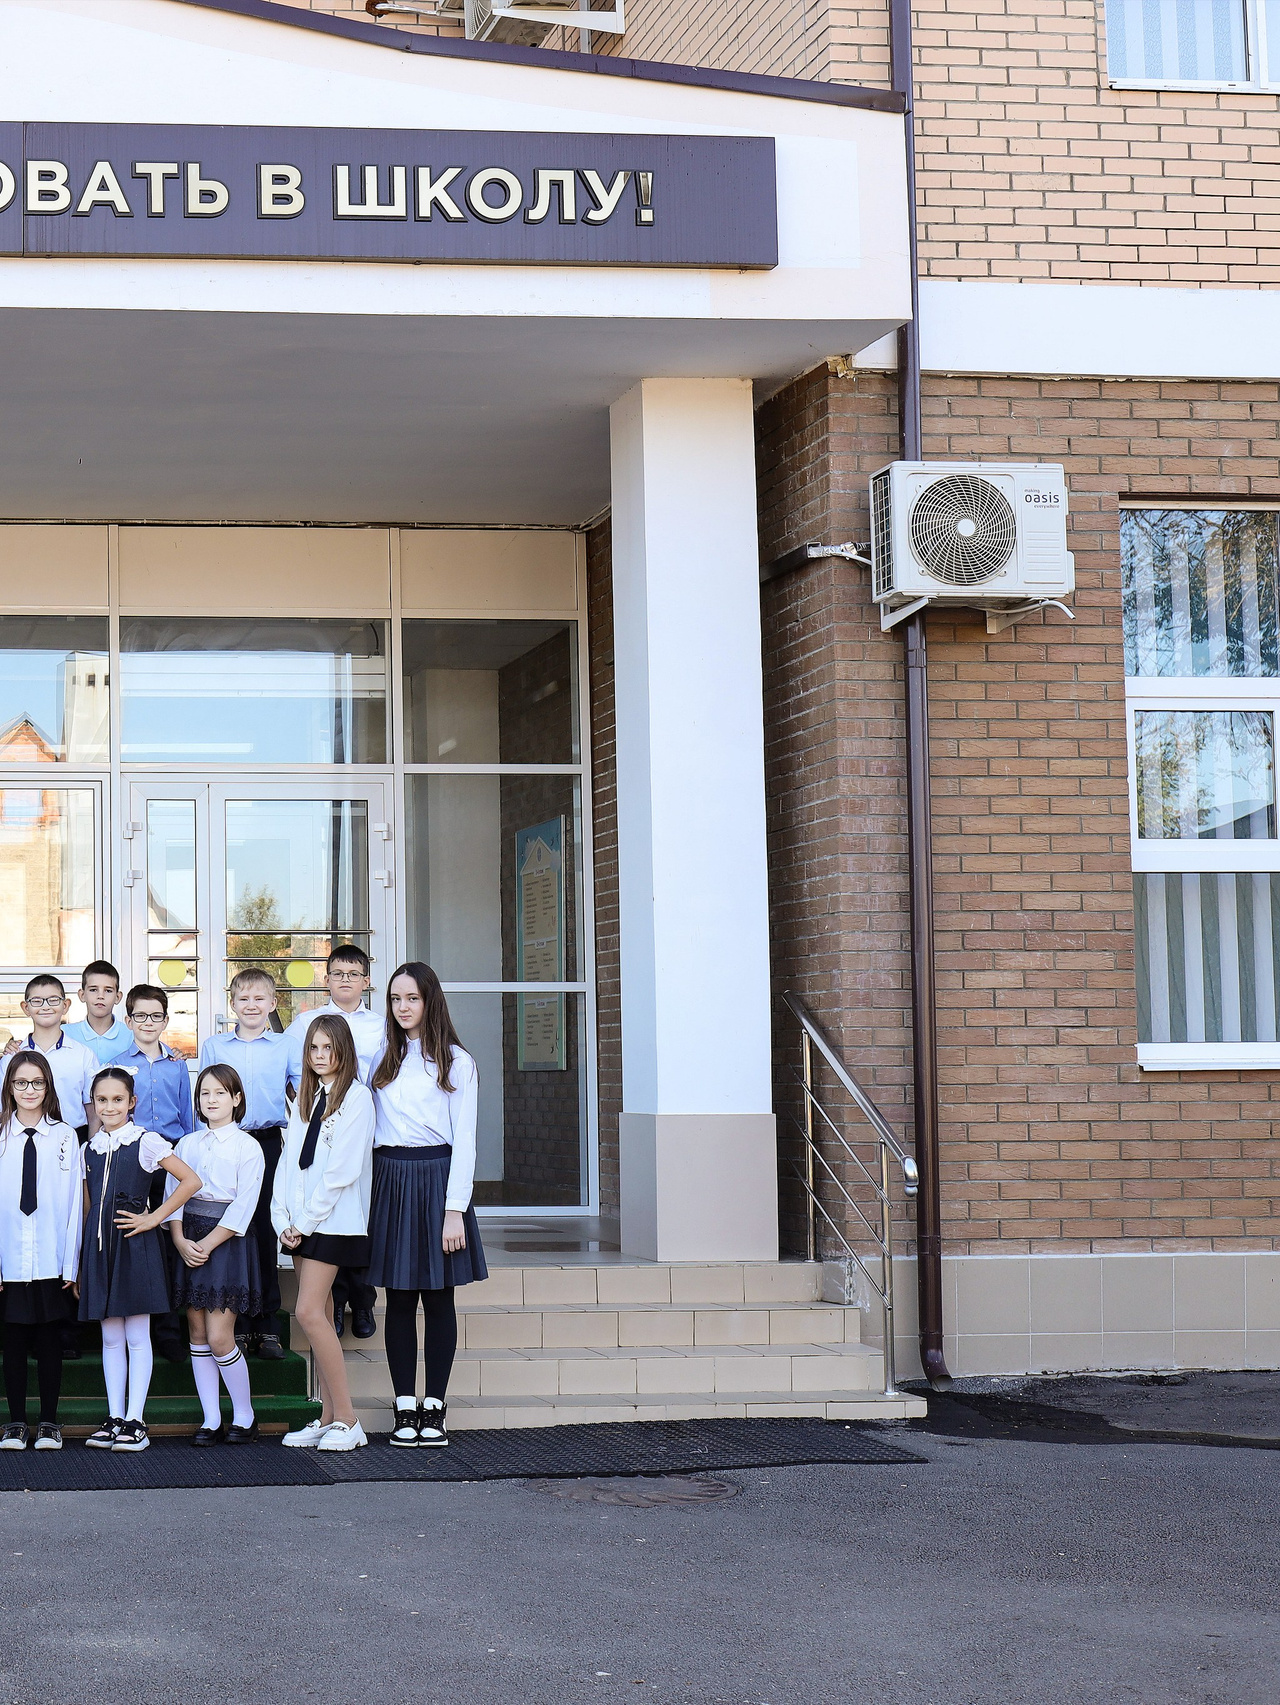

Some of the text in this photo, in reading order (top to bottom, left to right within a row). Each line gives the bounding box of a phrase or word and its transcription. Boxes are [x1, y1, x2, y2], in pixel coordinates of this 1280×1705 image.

[257, 163, 306, 219] В
[332, 163, 656, 226] ШКОЛУ!
[1024, 491, 1060, 504] oasis
